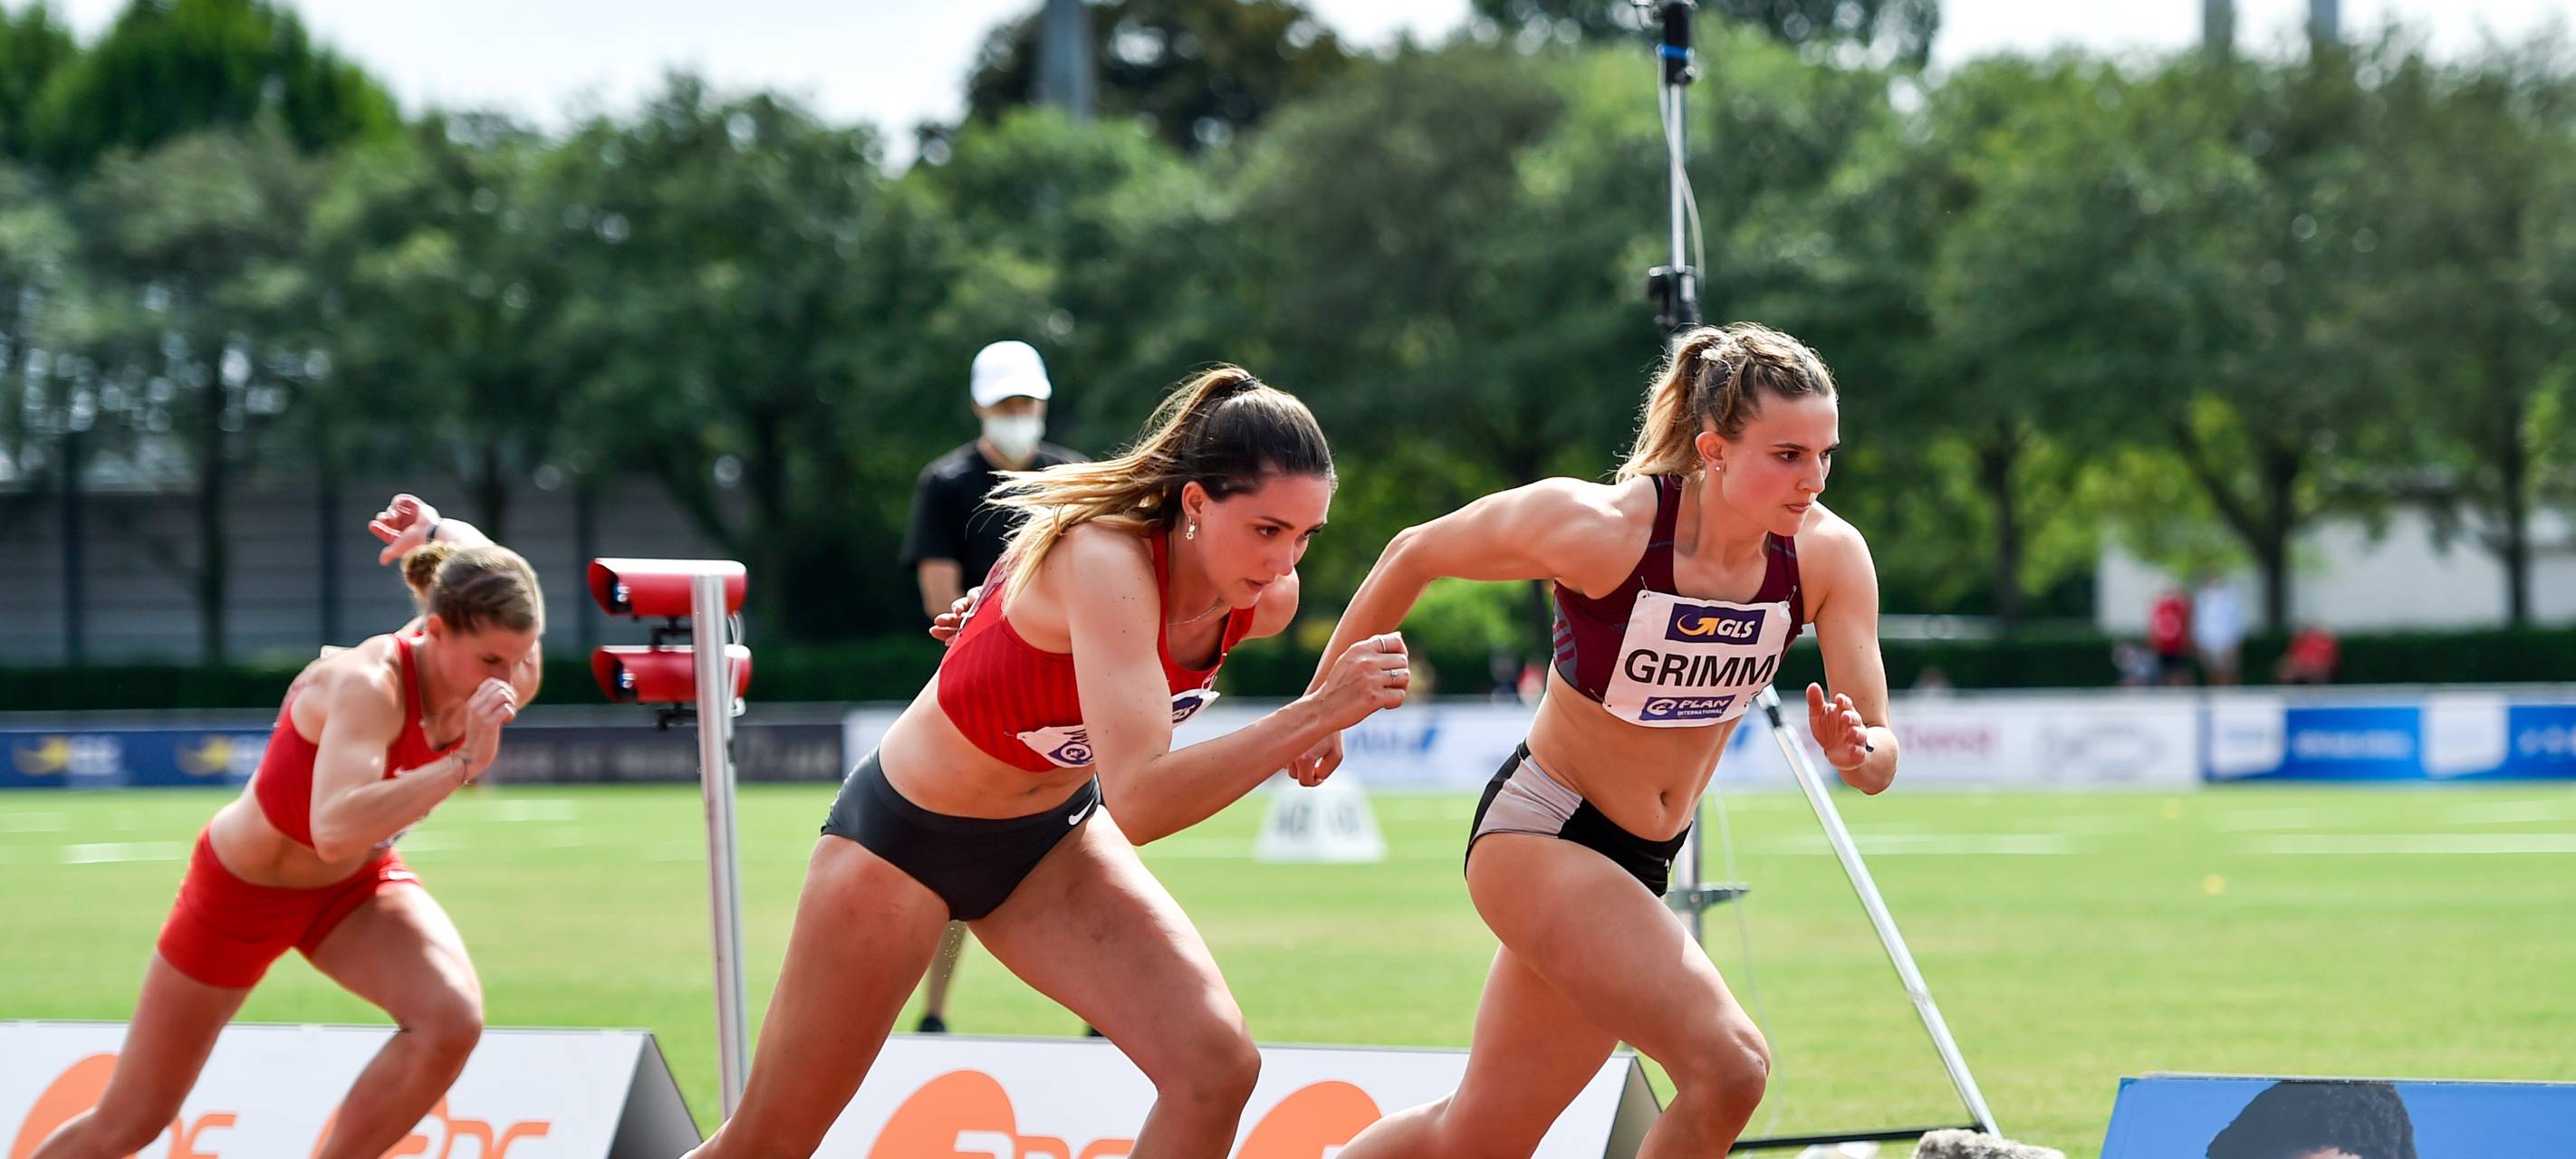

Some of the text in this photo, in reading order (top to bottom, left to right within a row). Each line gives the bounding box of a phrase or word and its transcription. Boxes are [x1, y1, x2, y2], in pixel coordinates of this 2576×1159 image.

[1716, 618, 1756, 638] GLS
[1624, 648, 1777, 687] GRIMM
[1678, 699, 1730, 709] PLAN
[1677, 708, 1723, 716] INTERNATIONAL
